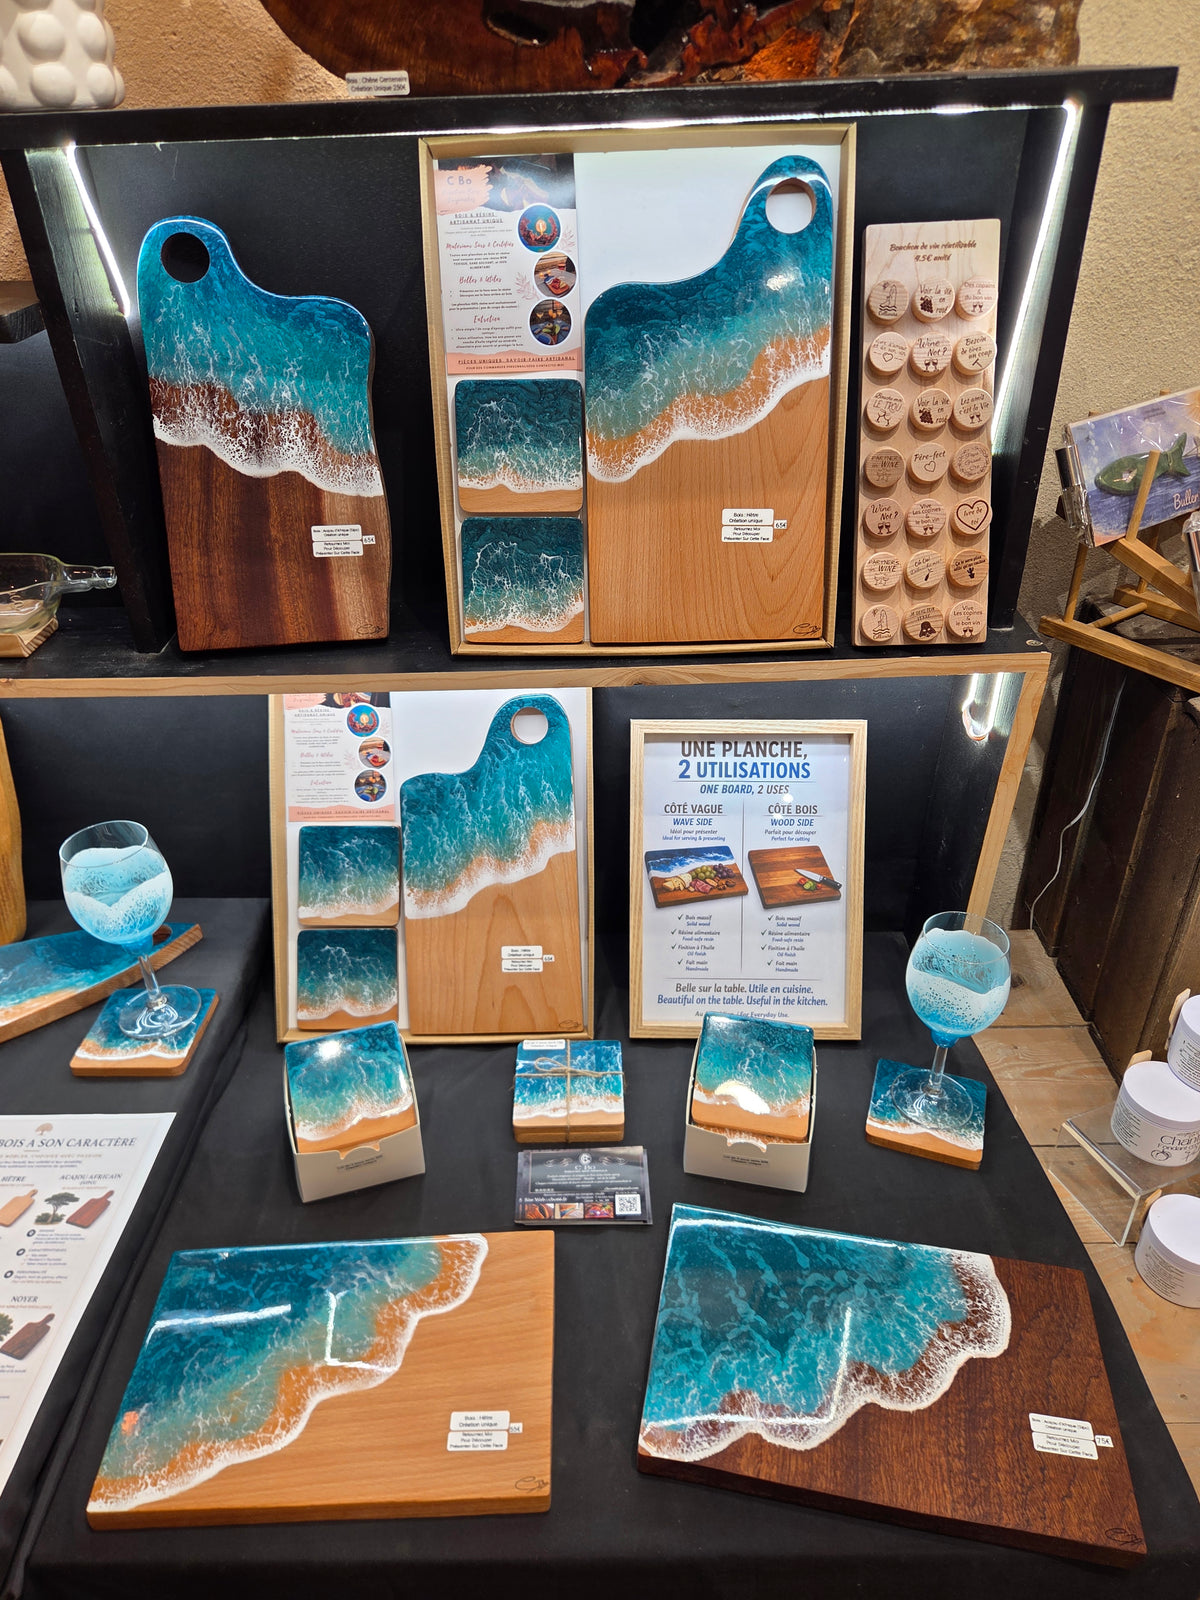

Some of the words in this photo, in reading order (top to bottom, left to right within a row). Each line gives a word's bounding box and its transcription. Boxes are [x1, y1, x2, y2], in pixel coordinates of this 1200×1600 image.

[890, 242, 919, 252] Bouchon
[927, 348, 941, 356] Not
[871, 504, 890, 513] Wine
[681, 741, 715, 757] UNE
[722, 741, 807, 760] PLANCHE,
[679, 759, 690, 779] 2
[697, 762, 810, 779] UTILISATIONS
[700, 784, 719, 794] ONE
[722, 784, 754, 795] BOARD,
[758, 785, 763, 794] 2
[766, 785, 789, 794] USES
[664, 802, 688, 813] CÔTÉ
[691, 804, 723, 813] VAGUE
[768, 803, 792, 814] CÔTÉ
[795, 805, 818, 814] BOIS
[676, 983, 696, 992] Belle
[714, 983, 722, 992] la
[724, 984, 747, 993] table.
[749, 984, 768, 993] Utile
[782, 985, 813, 994] cuisine.
[658, 994, 694, 1006] Beautiful
[708, 995, 720, 1004] the
[723, 995, 744, 1004] table.
[746, 996, 771, 1007] Useful
[773, 996, 780, 1005] in
[782, 996, 795, 1005] the
[797, 996, 828, 1006] kitchen.
[0, 1139, 25, 1147] BOIS
[26, 1139, 34, 1147] A
[38, 1139, 63, 1147] SON
[66, 1137, 137, 1147] CARACTÈRE
